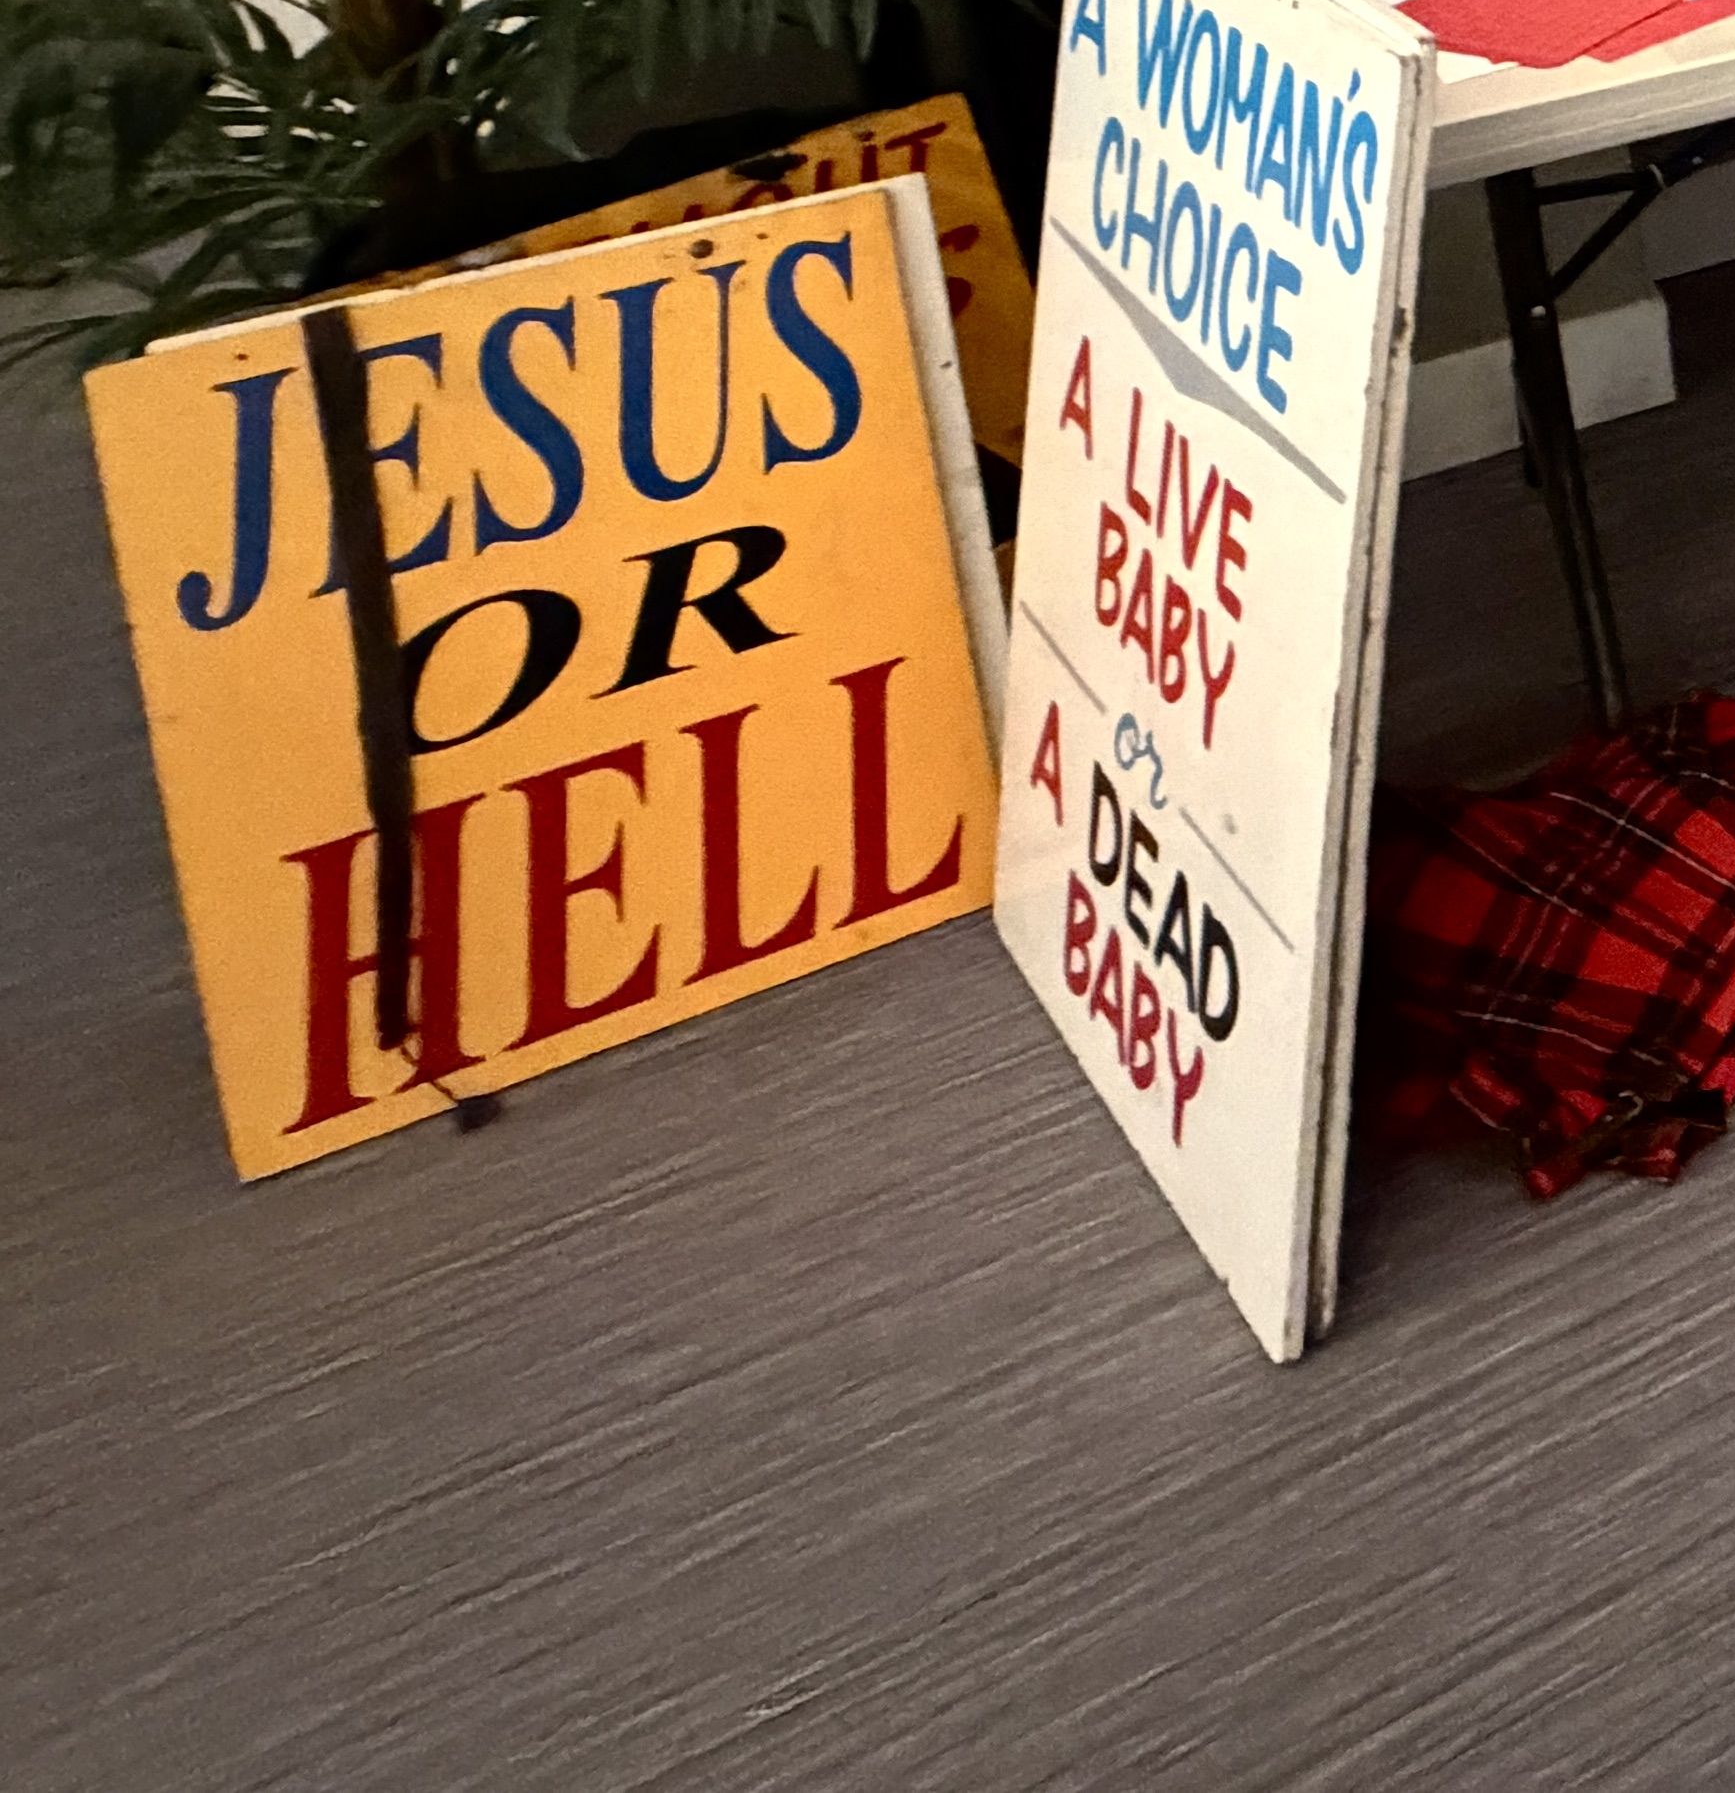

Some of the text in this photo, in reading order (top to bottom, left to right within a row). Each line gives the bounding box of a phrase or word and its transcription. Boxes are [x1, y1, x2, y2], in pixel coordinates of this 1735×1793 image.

[1092, 116, 1302, 414] CHOICE
[177, 230, 864, 633] JESUS
[1060, 335, 1254, 622] A LIVE
[394, 523, 801, 758] OR
[1094, 501, 1236, 750] BABY
[280, 655, 966, 1138] HELL
[1029, 701, 1240, 1042] A DEAD
[1063, 869, 1205, 1148] BABY
